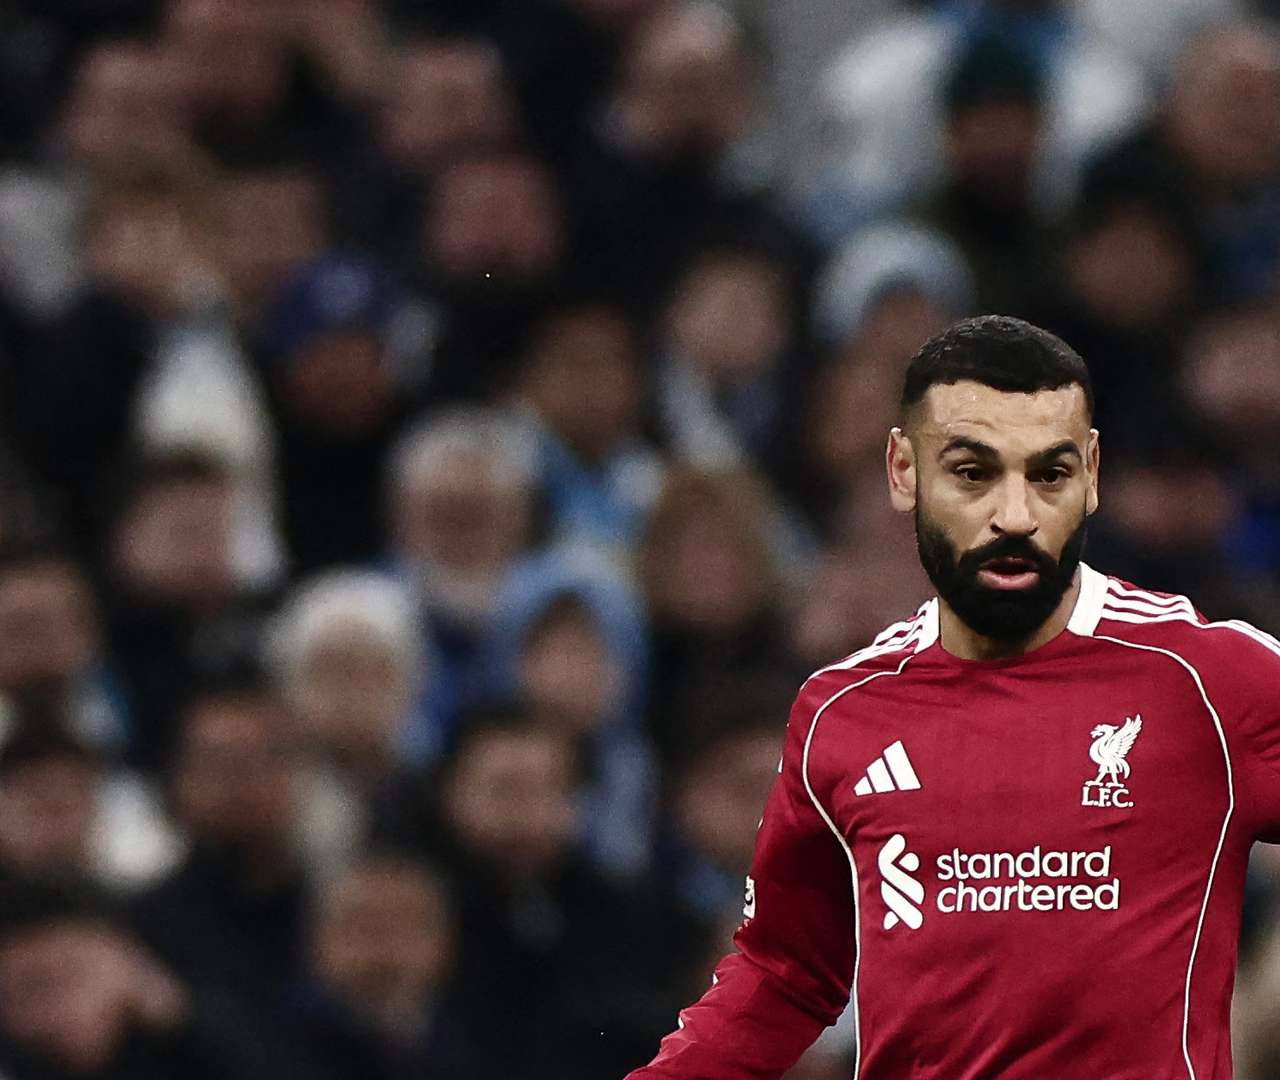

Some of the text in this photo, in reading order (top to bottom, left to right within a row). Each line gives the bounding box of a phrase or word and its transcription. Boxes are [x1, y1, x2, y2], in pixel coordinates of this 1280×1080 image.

[1081, 786, 1134, 808] L.F.C.
[936, 845, 1111, 881] standard
[936, 877, 1120, 913] chartered
